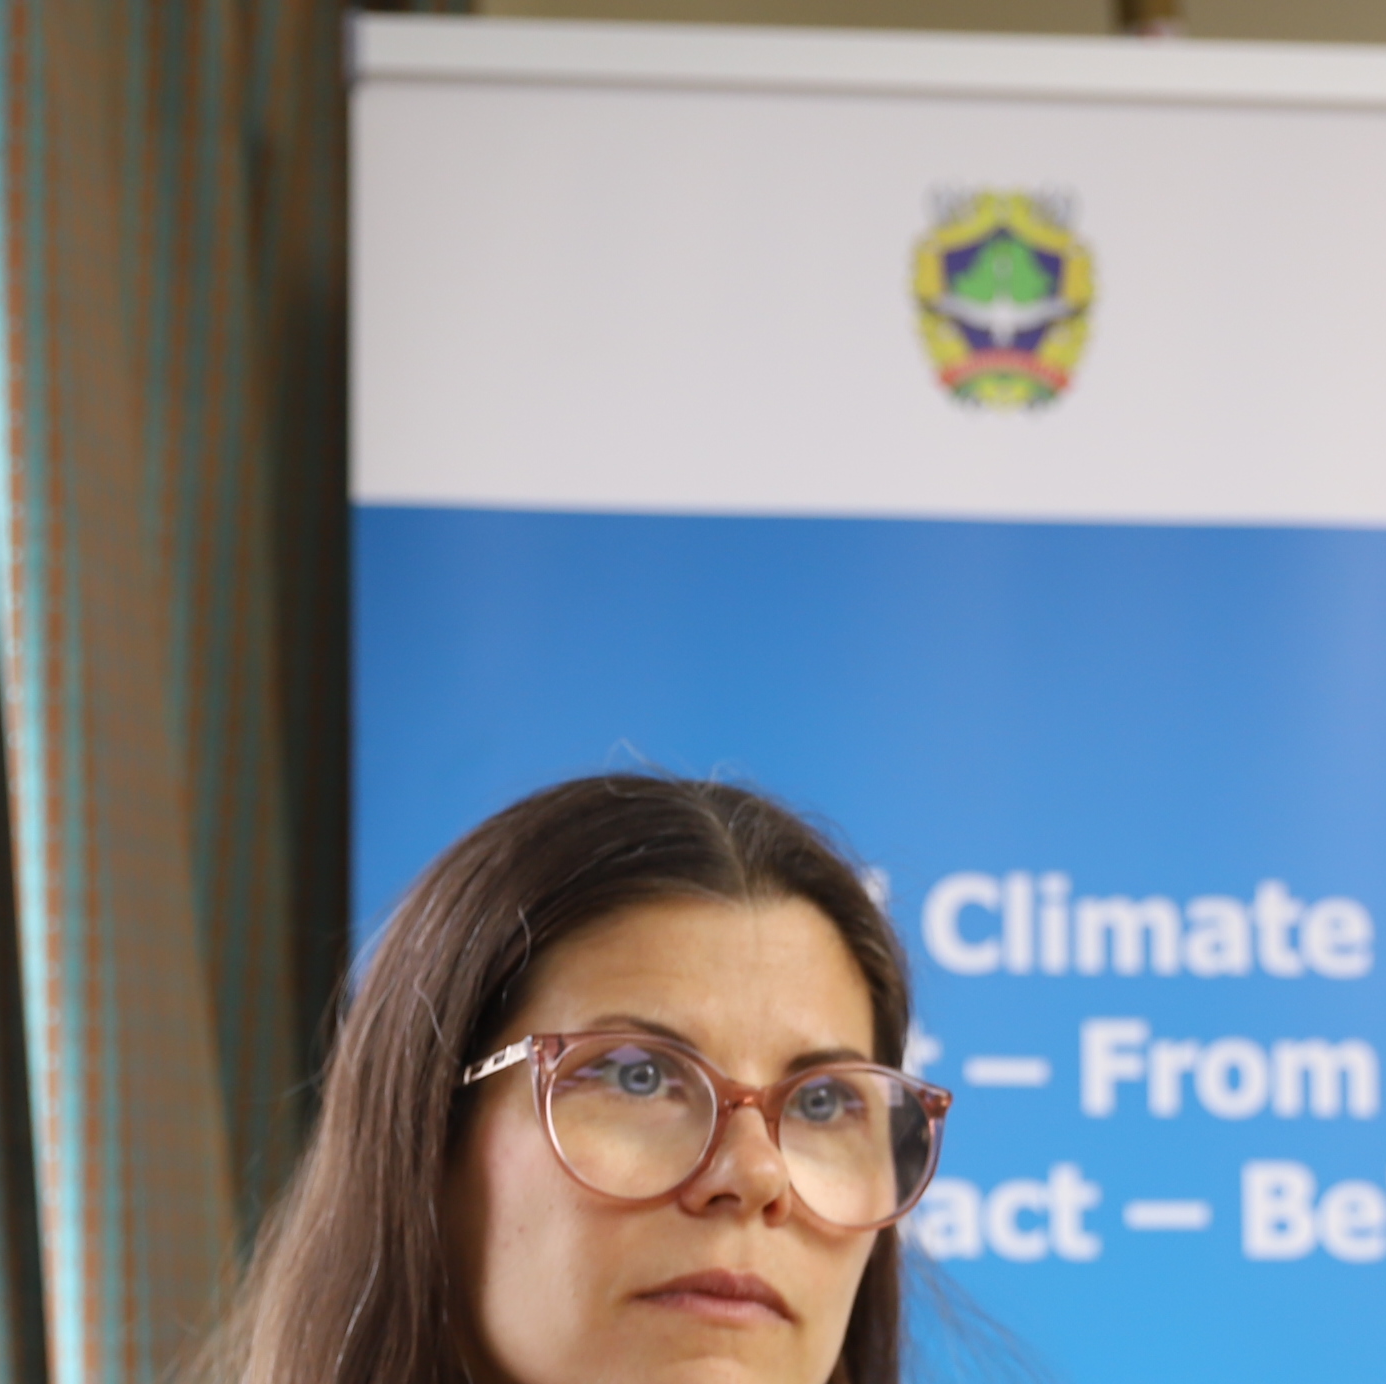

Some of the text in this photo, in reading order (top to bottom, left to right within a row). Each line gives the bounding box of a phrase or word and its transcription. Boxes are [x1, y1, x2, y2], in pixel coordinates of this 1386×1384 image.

[923, 871, 1374, 979] Climate
[1081, 1018, 1380, 1119] From
[899, 1163, 1101, 1262] act
